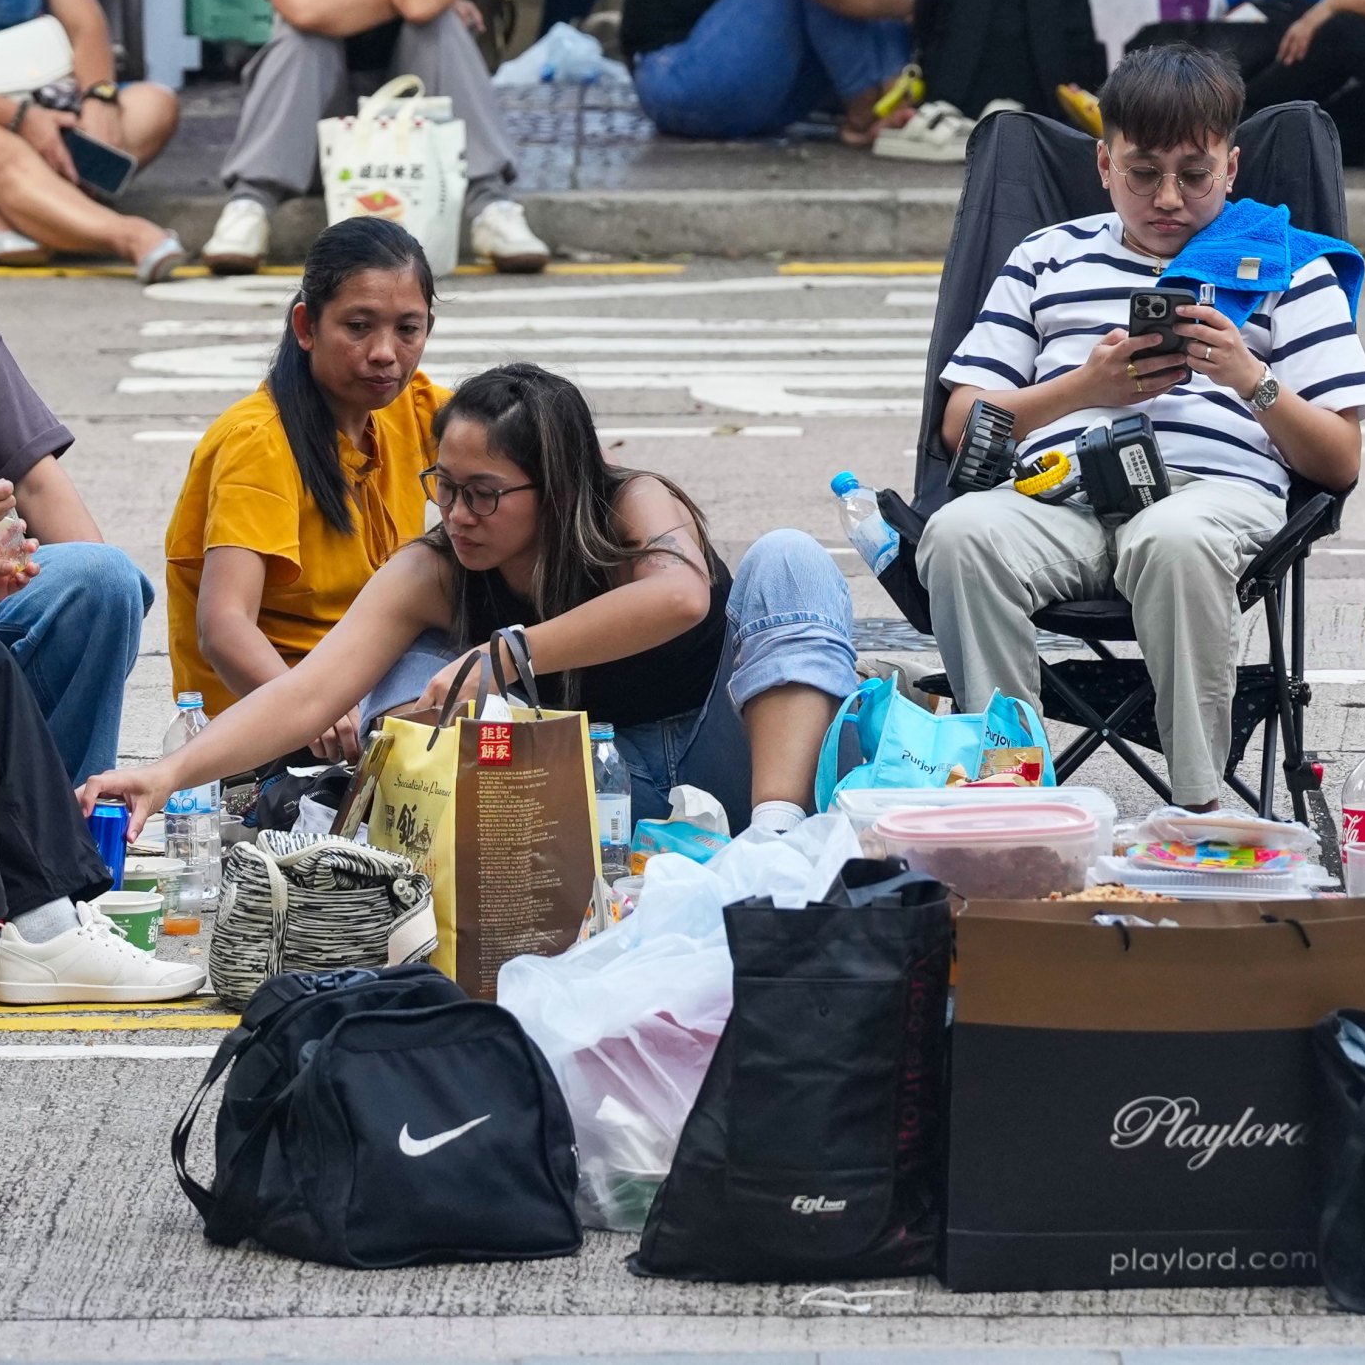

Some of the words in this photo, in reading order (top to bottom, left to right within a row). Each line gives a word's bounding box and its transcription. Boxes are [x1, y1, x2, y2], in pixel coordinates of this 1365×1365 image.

[481, 726, 511, 740] 鉅記
[480, 744, 510, 759] 餅家
[901, 750, 937, 775] Purjoy
[1109, 1245, 1317, 1276] playlord.com
